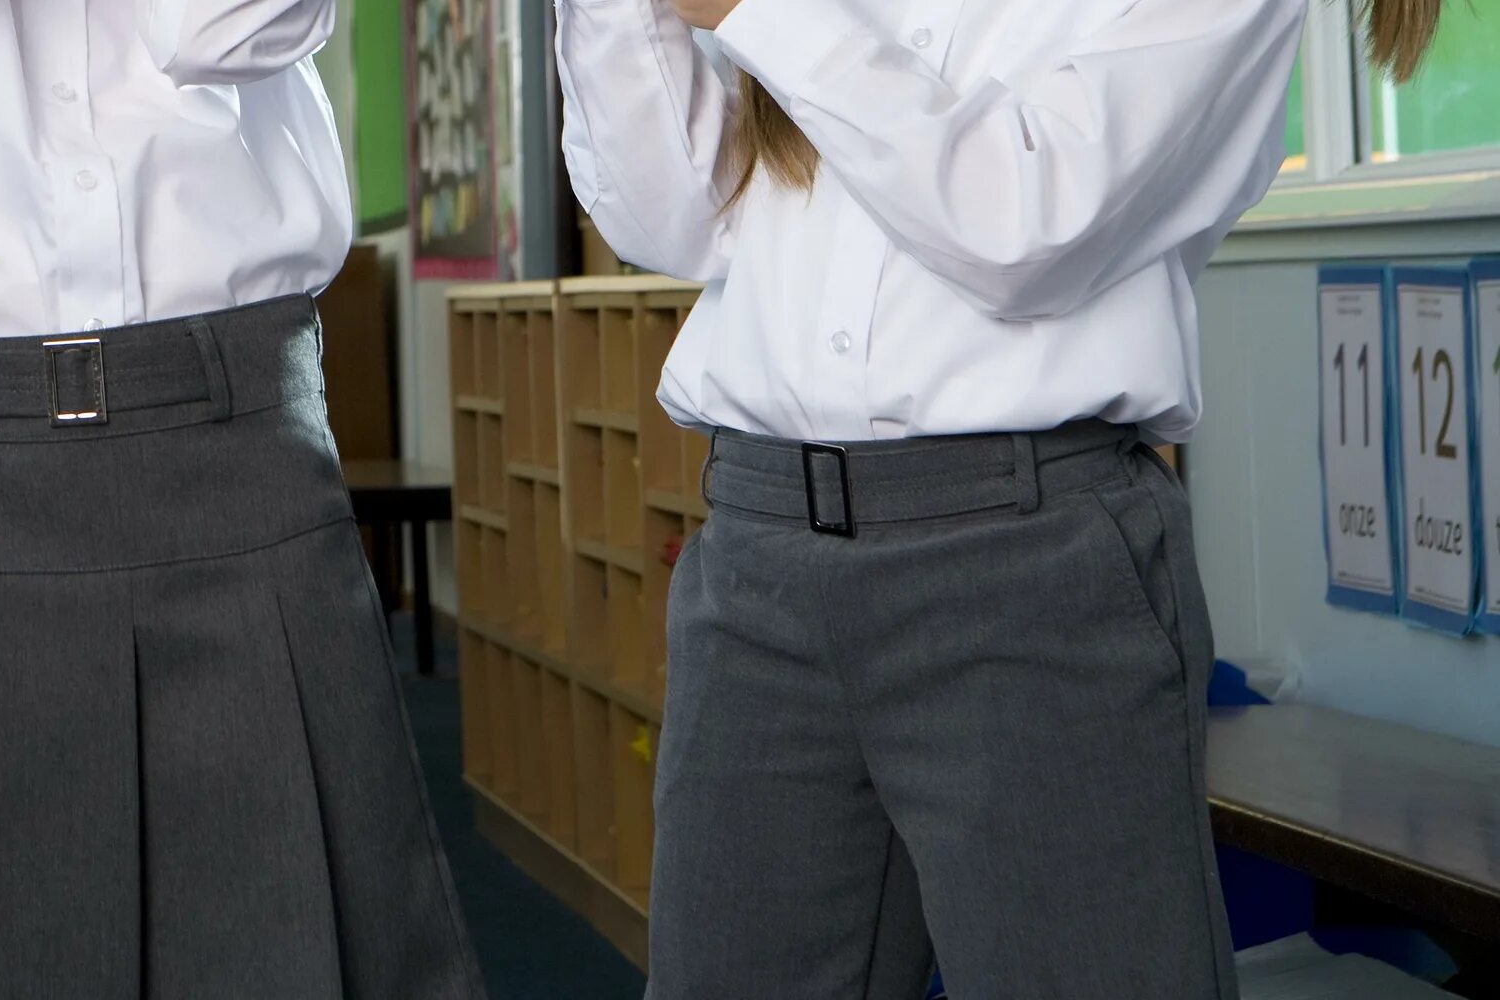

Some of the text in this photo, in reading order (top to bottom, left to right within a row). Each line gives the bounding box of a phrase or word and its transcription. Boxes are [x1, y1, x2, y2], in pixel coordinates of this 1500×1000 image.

[1333, 342, 1369, 448] 11
[1412, 346, 1457, 459] 12
[1338, 503, 1376, 538] onze
[1414, 497, 1463, 556] douze
